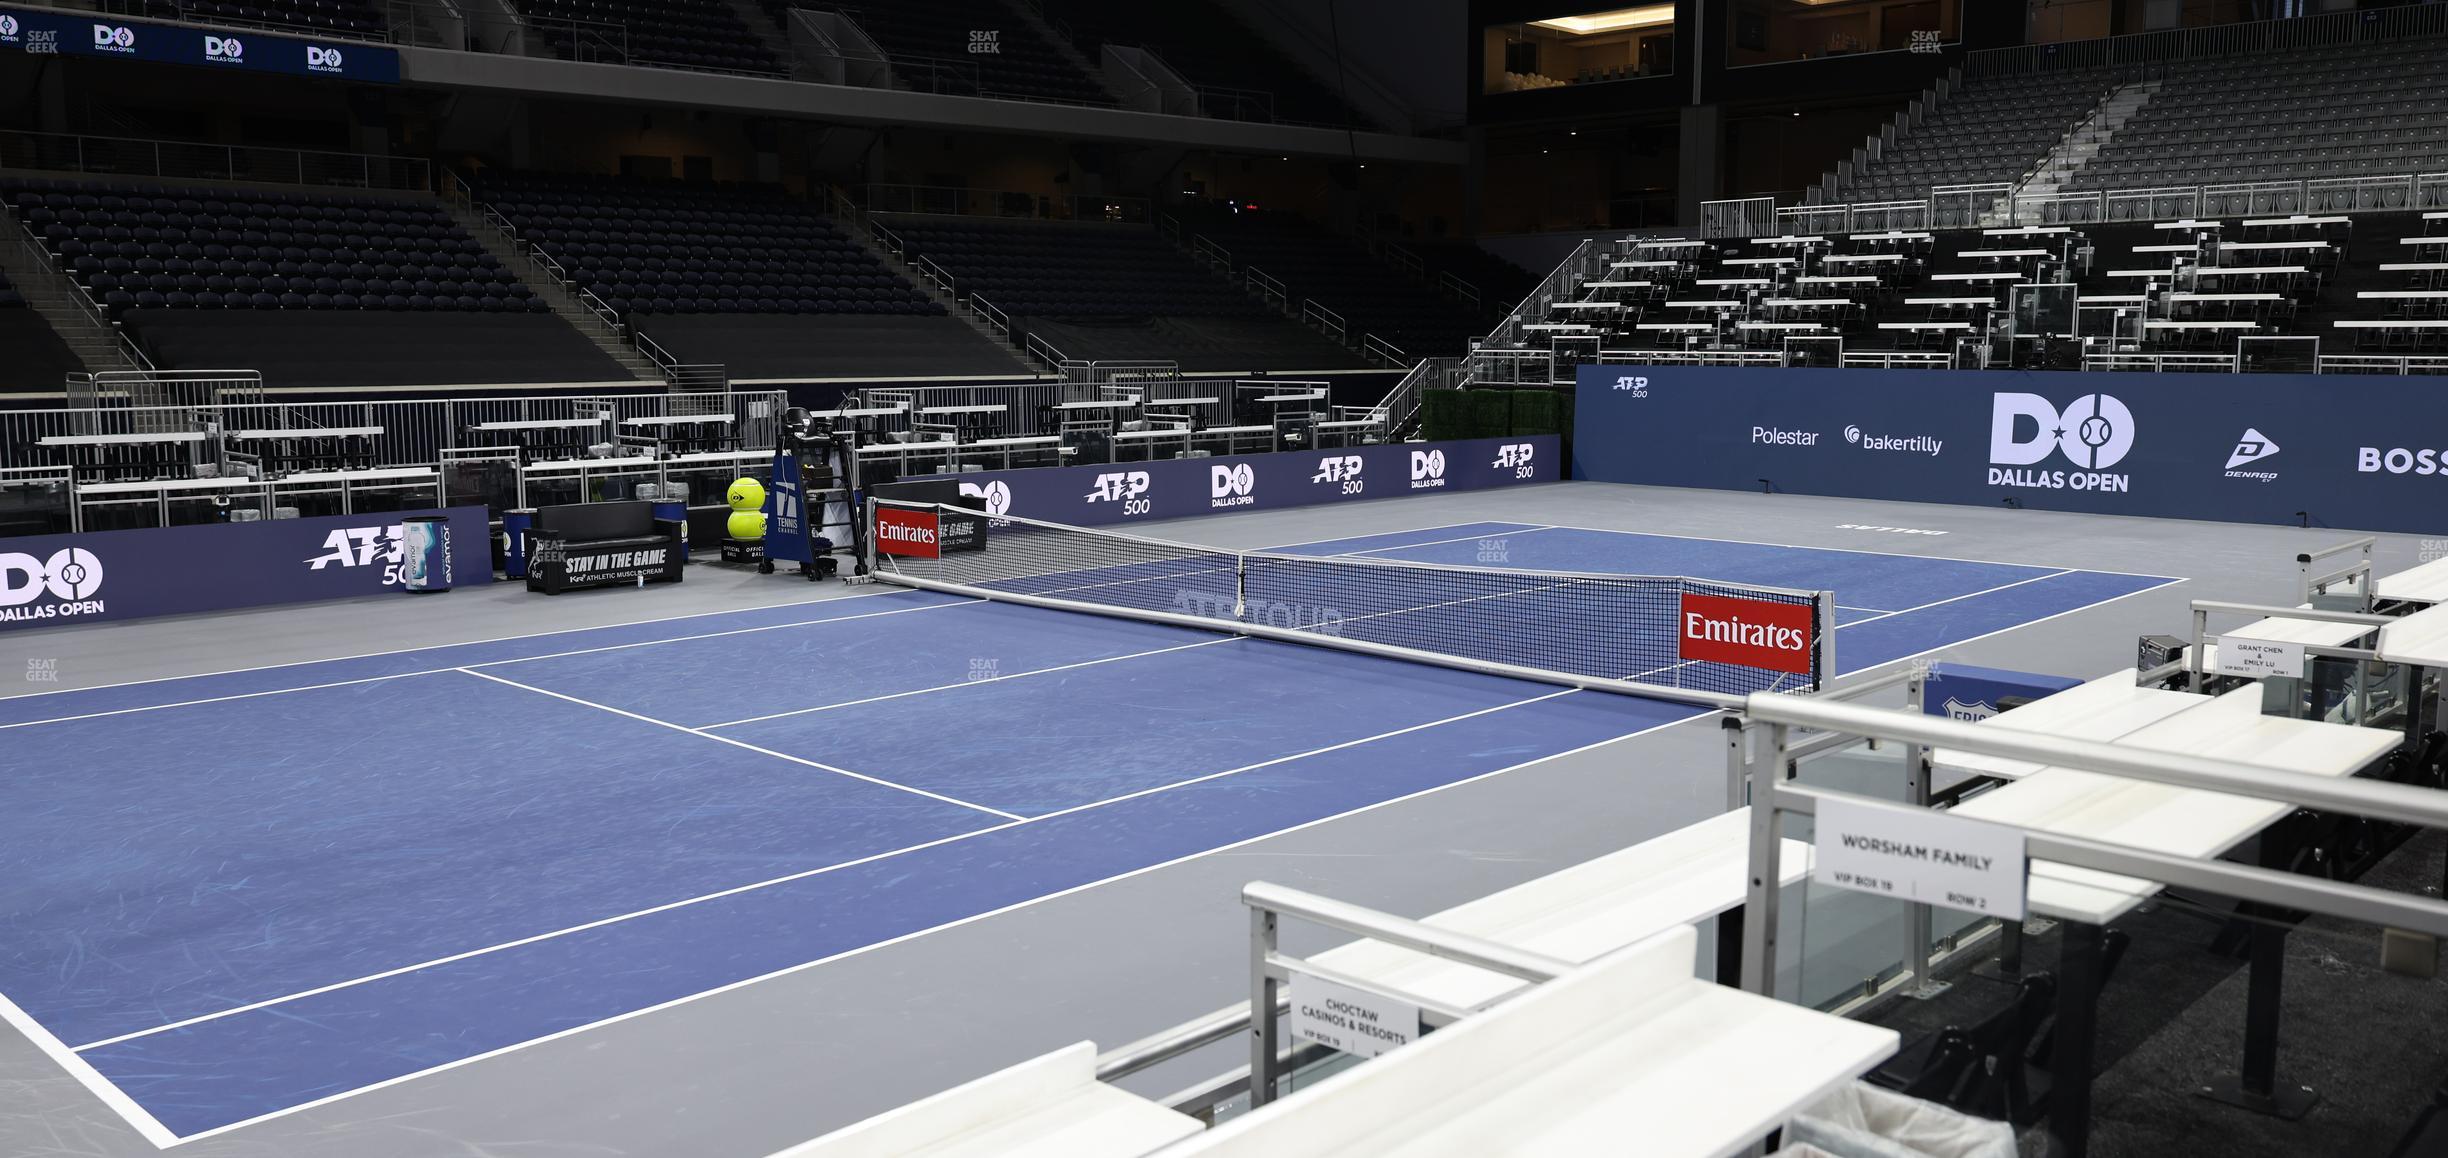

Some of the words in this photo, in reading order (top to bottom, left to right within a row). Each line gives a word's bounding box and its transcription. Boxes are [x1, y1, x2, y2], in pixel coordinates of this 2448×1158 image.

[1612, 376, 1648, 390] ATP
[1632, 390, 1648, 398] 500
[1753, 426, 1819, 446] Polestar
[1863, 434, 1943, 456] bakertilly
[1491, 443, 1534, 468] ATP
[1311, 455, 1363, 483] ATP
[1516, 466, 1534, 479] 500
[2224, 471, 2278, 479] DENAGO
[1083, 471, 1150, 503] ATP
[1342, 480, 1363, 495] 500
[1411, 480, 1430, 489] DALLAS
[1430, 479, 1445, 487] OPEN
[1988, 468, 2065, 489] DALLAS
[2069, 472, 2129, 493] OPEN
[1123, 499, 1150, 515] 500
[1212, 497, 1235, 508] DALLAS
[1236, 496, 1254, 505] OPEN
[777, 517, 798, 529] TENNIS
[778, 527, 798, 535] CHANNEL
[879, 520, 935, 545] Emirates
[443, 525, 452, 584] evamor
[566, 556, 595, 573] STAY
[595, 554, 609, 571] IN
[611, 552, 632, 569] THE
[633, 548, 667, 566] GAME
[587, 573, 616, 581] ATHLETIC
[642, 568, 663, 576] CREAM
[59, 600, 104, 616] OPEN
[1686, 612, 1803, 651] Emirates
[2237, 644, 2262, 652] GRANT
[2263, 646, 2283, 654] CHEN
[1841, 833, 1928, 861] WORSHAM
[1932, 849, 1993, 871] FAMILY
[1834, 871, 1852, 882] VIP
[1854, 874, 1878, 890] BOX
[1946, 891, 1976, 906] ROW
[1326, 998, 1378, 1022] CHOCTAW
[1302, 1005, 1346, 1028] CASINOS
[1349, 1020, 1356, 1031] &
[1358, 1021, 1407, 1046] RESORTS
[1303, 1029, 1315, 1038] VIP
